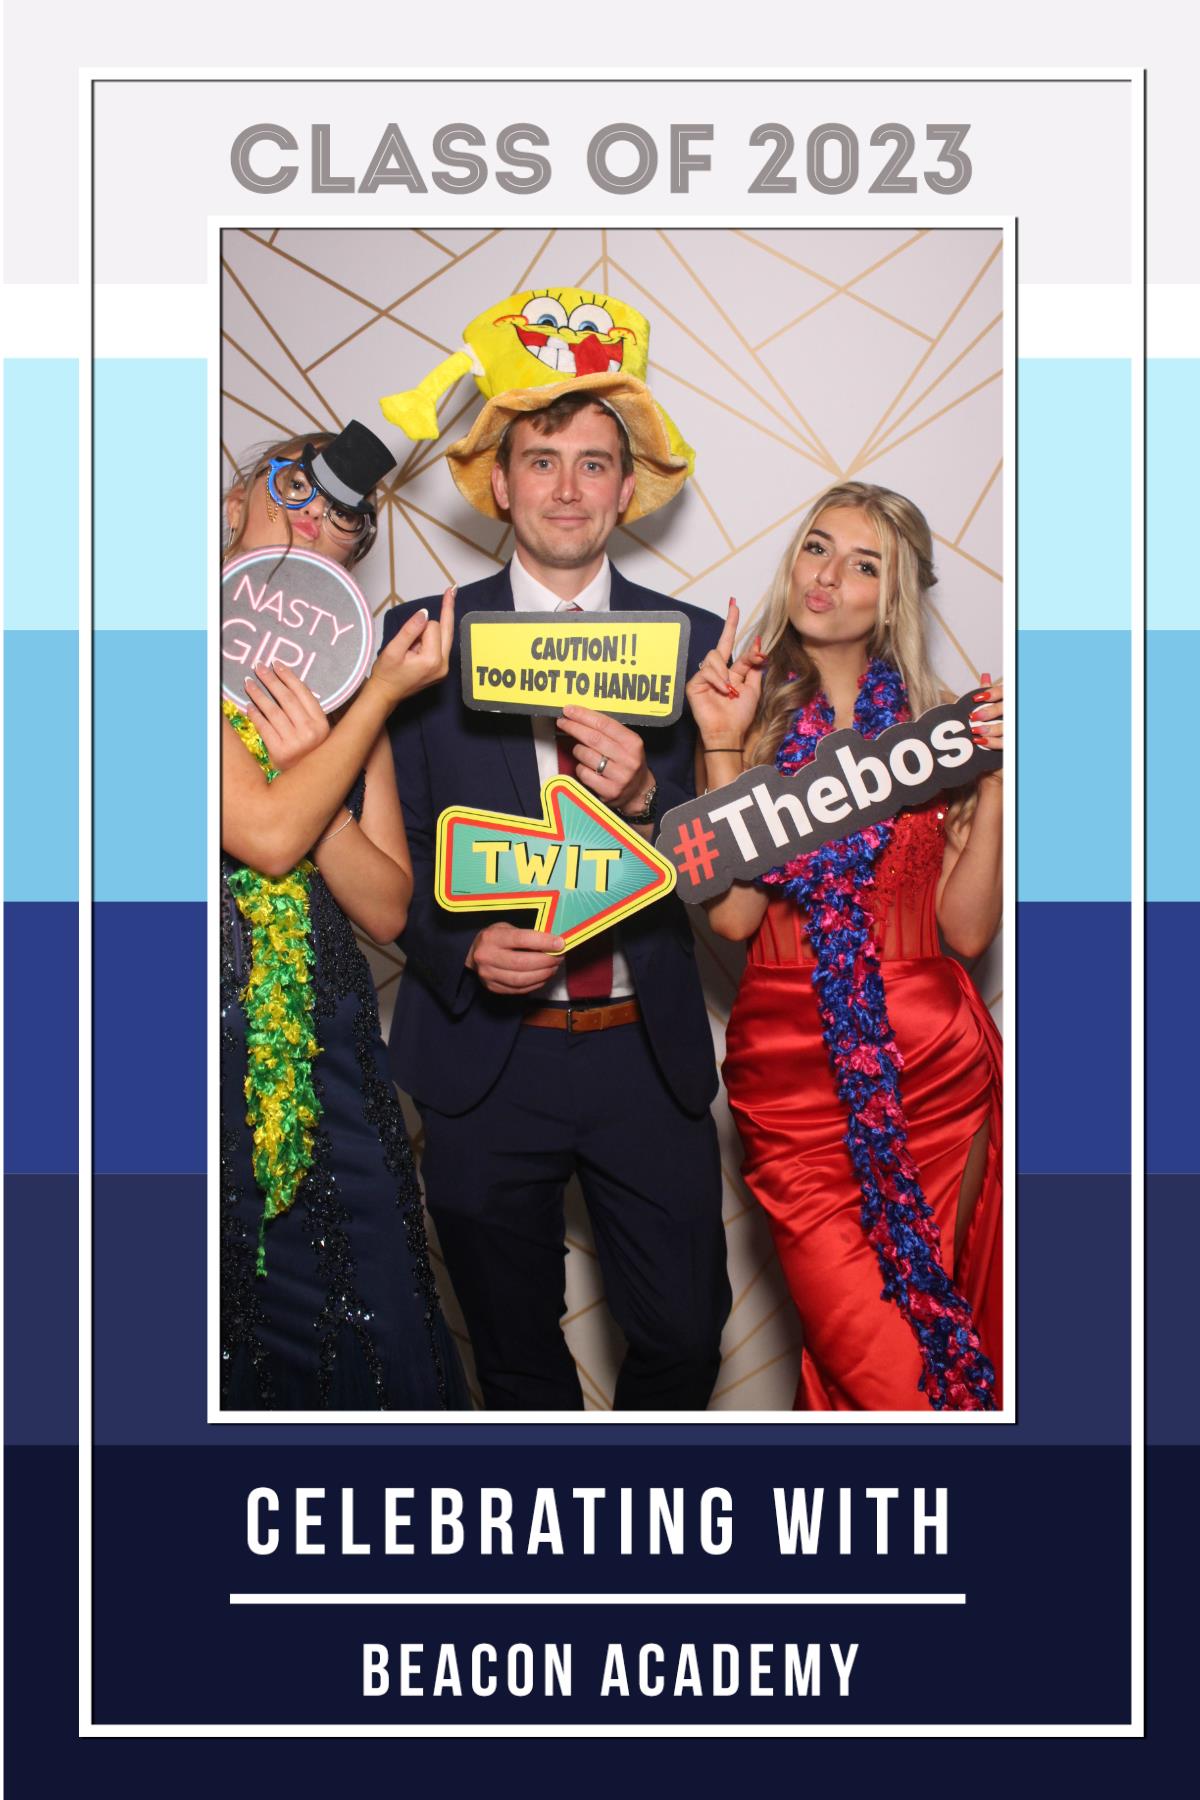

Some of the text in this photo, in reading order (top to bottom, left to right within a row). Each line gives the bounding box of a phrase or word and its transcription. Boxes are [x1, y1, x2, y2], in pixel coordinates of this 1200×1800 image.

[233, 574, 355, 646] NASTY
[530, 633, 638, 666] CAUTION!!
[476, 666, 672, 704] TOO HOT TO HANDLE
[472, 840, 622, 893] TWIT
